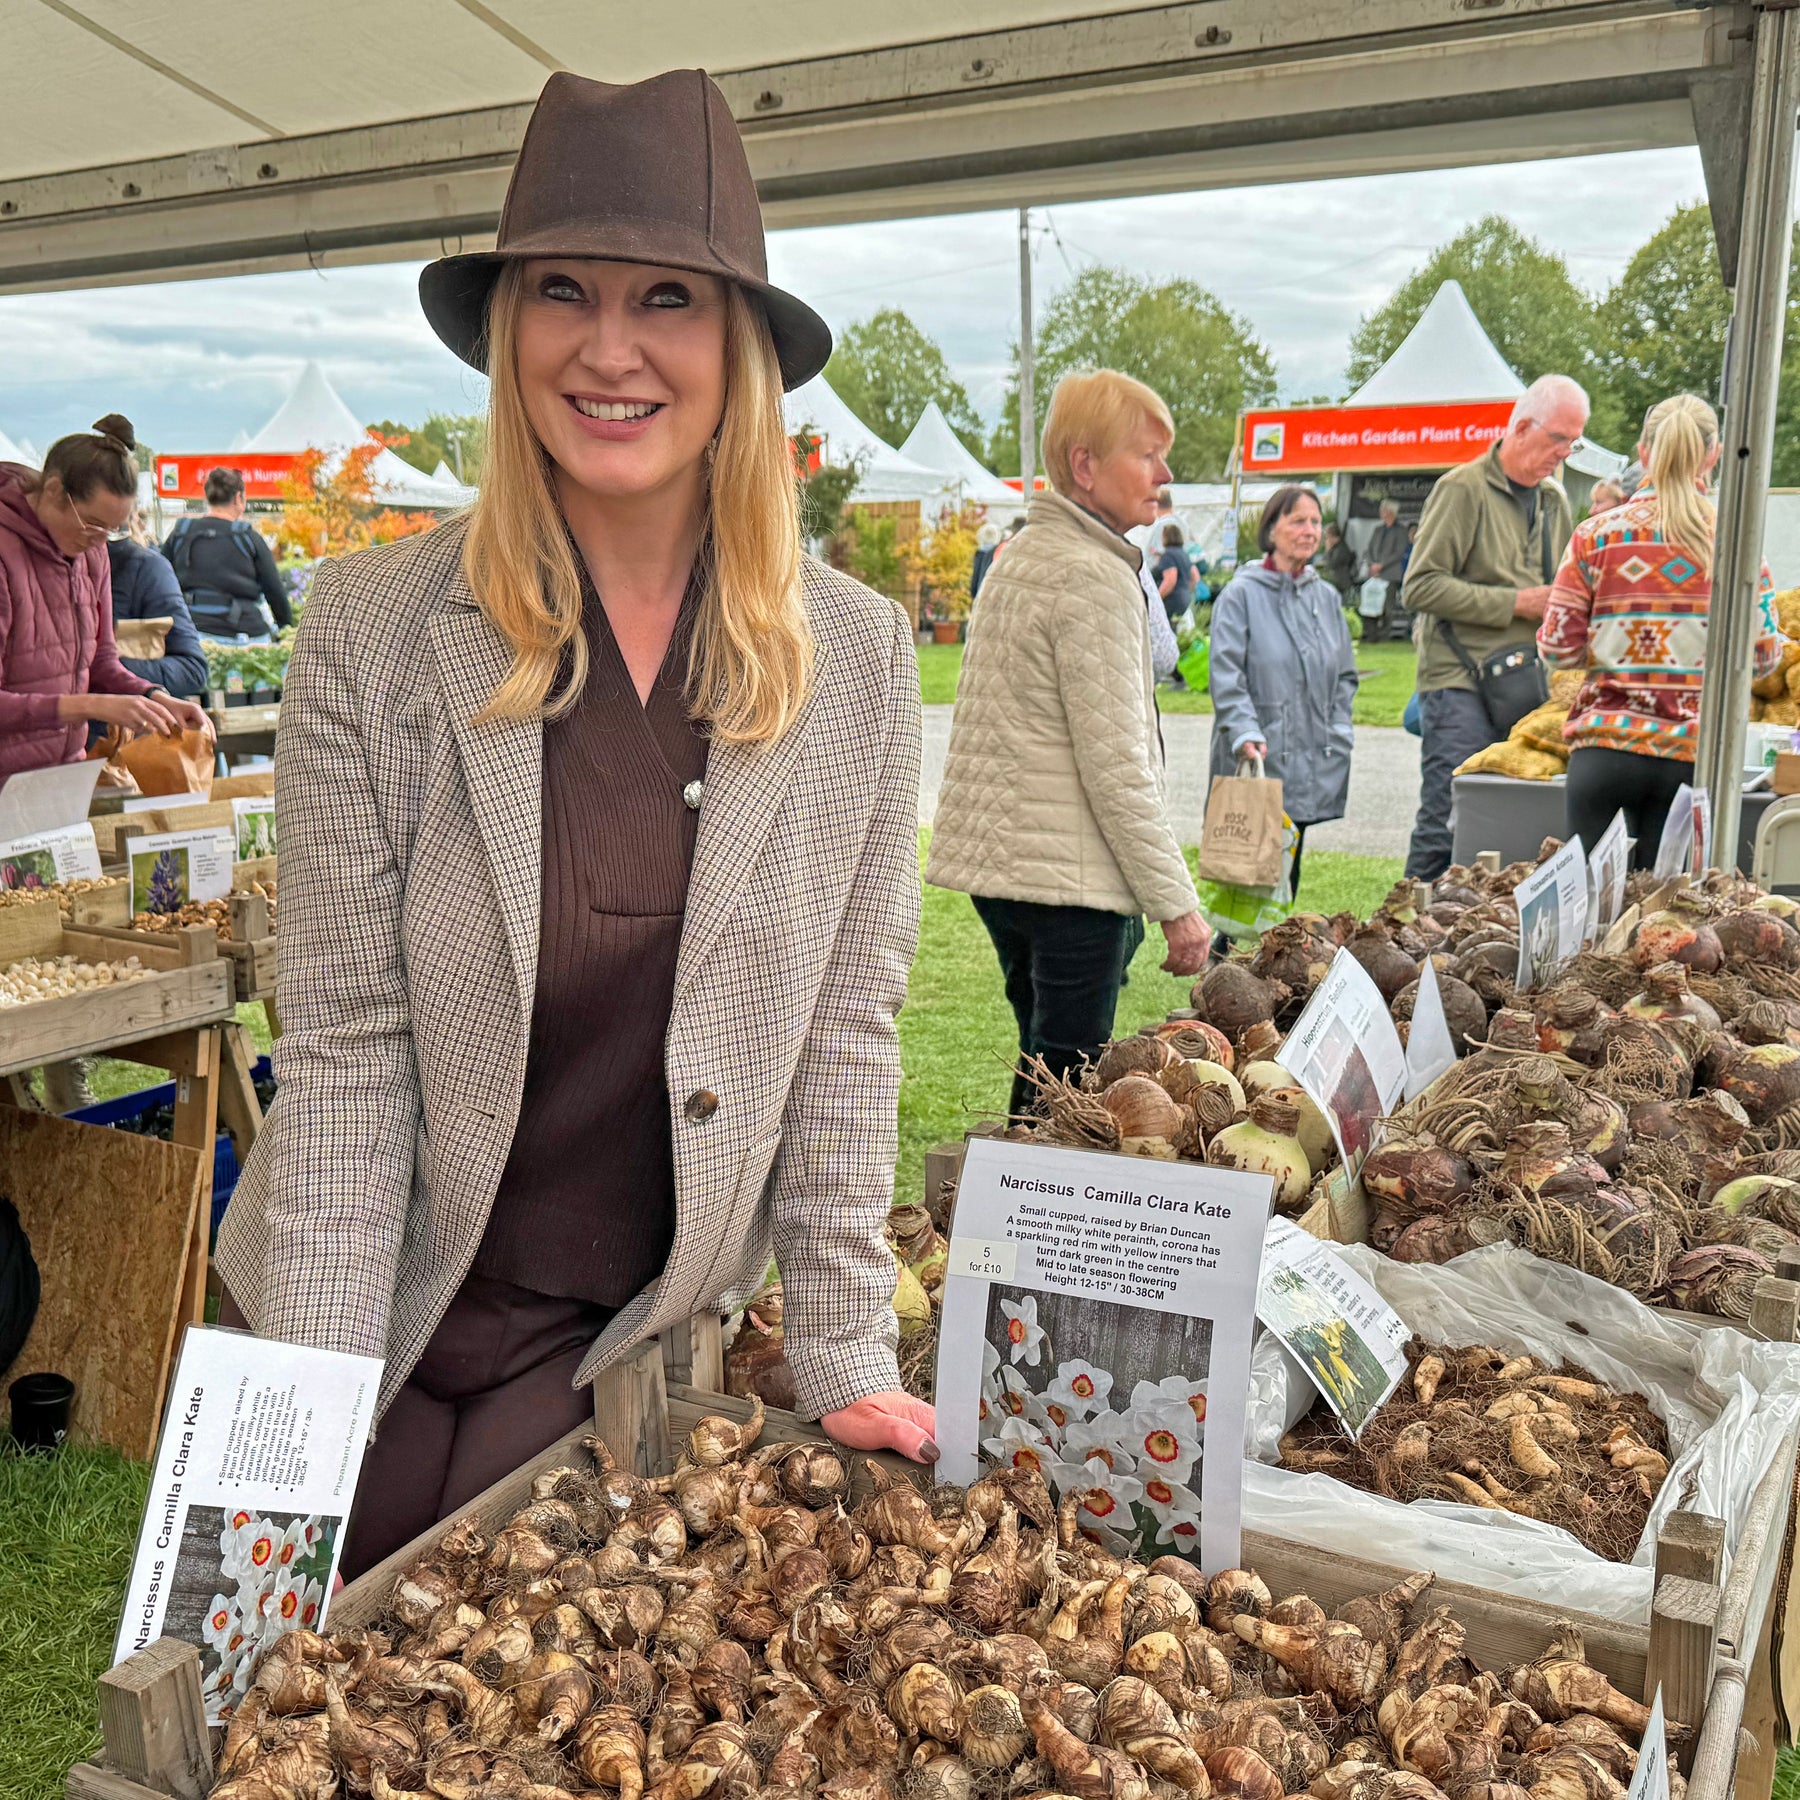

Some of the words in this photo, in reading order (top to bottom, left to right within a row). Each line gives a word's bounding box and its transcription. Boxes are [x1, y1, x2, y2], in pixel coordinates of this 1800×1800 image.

[1302, 429, 1359, 448] Kitchen
[1361, 427, 1416, 445] Garden
[1420, 425, 1460, 442] Plant
[1465, 424, 1509, 441] Centr
[1213, 824, 1252, 842] COTTAGE
[1000, 1174, 1075, 1197] Narcissus
[1084, 1186, 1142, 1206] Camilla
[1147, 1195, 1189, 1213] Clara
[1194, 1200, 1232, 1219] Kate
[1007, 1216, 1014, 1224] A
[1016, 1217, 1053, 1230] smooth
[1055, 1222, 1082, 1236] milky
[1085, 1227, 1111, 1239] white
[1114, 1232, 1159, 1248] perainth,
[1162, 1240, 1199, 1253] corona
[1202, 1244, 1221, 1256] has
[1019, 1205, 1047, 1217] Small
[1049, 1208, 1088, 1224] cupped,
[1091, 1214, 1122, 1228] raised
[1125, 1219, 1137, 1231] by
[1140, 1222, 1167, 1234] Brian
[1170, 1226, 1211, 1241] Duncan
[984, 1247, 990, 1257] 5
[1015, 1228, 1060, 1246] sparkling
[1063, 1236, 1079, 1247] red
[1082, 1239, 1098, 1250] rim
[1101, 1241, 1121, 1253] with
[1124, 1245, 1158, 1260] yellow
[1160, 1251, 1193, 1265] inners
[1196, 1256, 1217, 1269] that
[1037, 1247, 1057, 1256] turn
[1060, 1249, 1082, 1261] dark
[1084, 1254, 1112, 1267] green
[1115, 1256, 1125, 1267] in
[1128, 1259, 1144, 1270] the
[1147, 1264, 1180, 1276] centre
[970, 1262, 982, 1271] for
[984, 1263, 1001, 1273] £10
[1036, 1258, 1054, 1269] Mid
[1056, 1261, 1066, 1271] to
[1069, 1262, 1087, 1274] late
[1090, 1268, 1126, 1281] season
[1128, 1272, 1177, 1291] flowering
[1045, 1272, 1077, 1287] Height
[1080, 1277, 1112, 1291] 12-15"
[1114, 1283, 1118, 1292] /
[1120, 1284, 1164, 1300] 30-38CM
[233, 1421, 246, 1453] Duncan
[333, 1445, 351, 1496] Pheasant
[347, 1418, 357, 1444] Acre
[352, 1382, 365, 1415] Plants
[134, 1560, 164, 1651] Narcissus
[156, 1483, 182, 1549] Camilla
[172, 1431, 193, 1477] Clara
[183, 1386, 204, 1426] Kate
